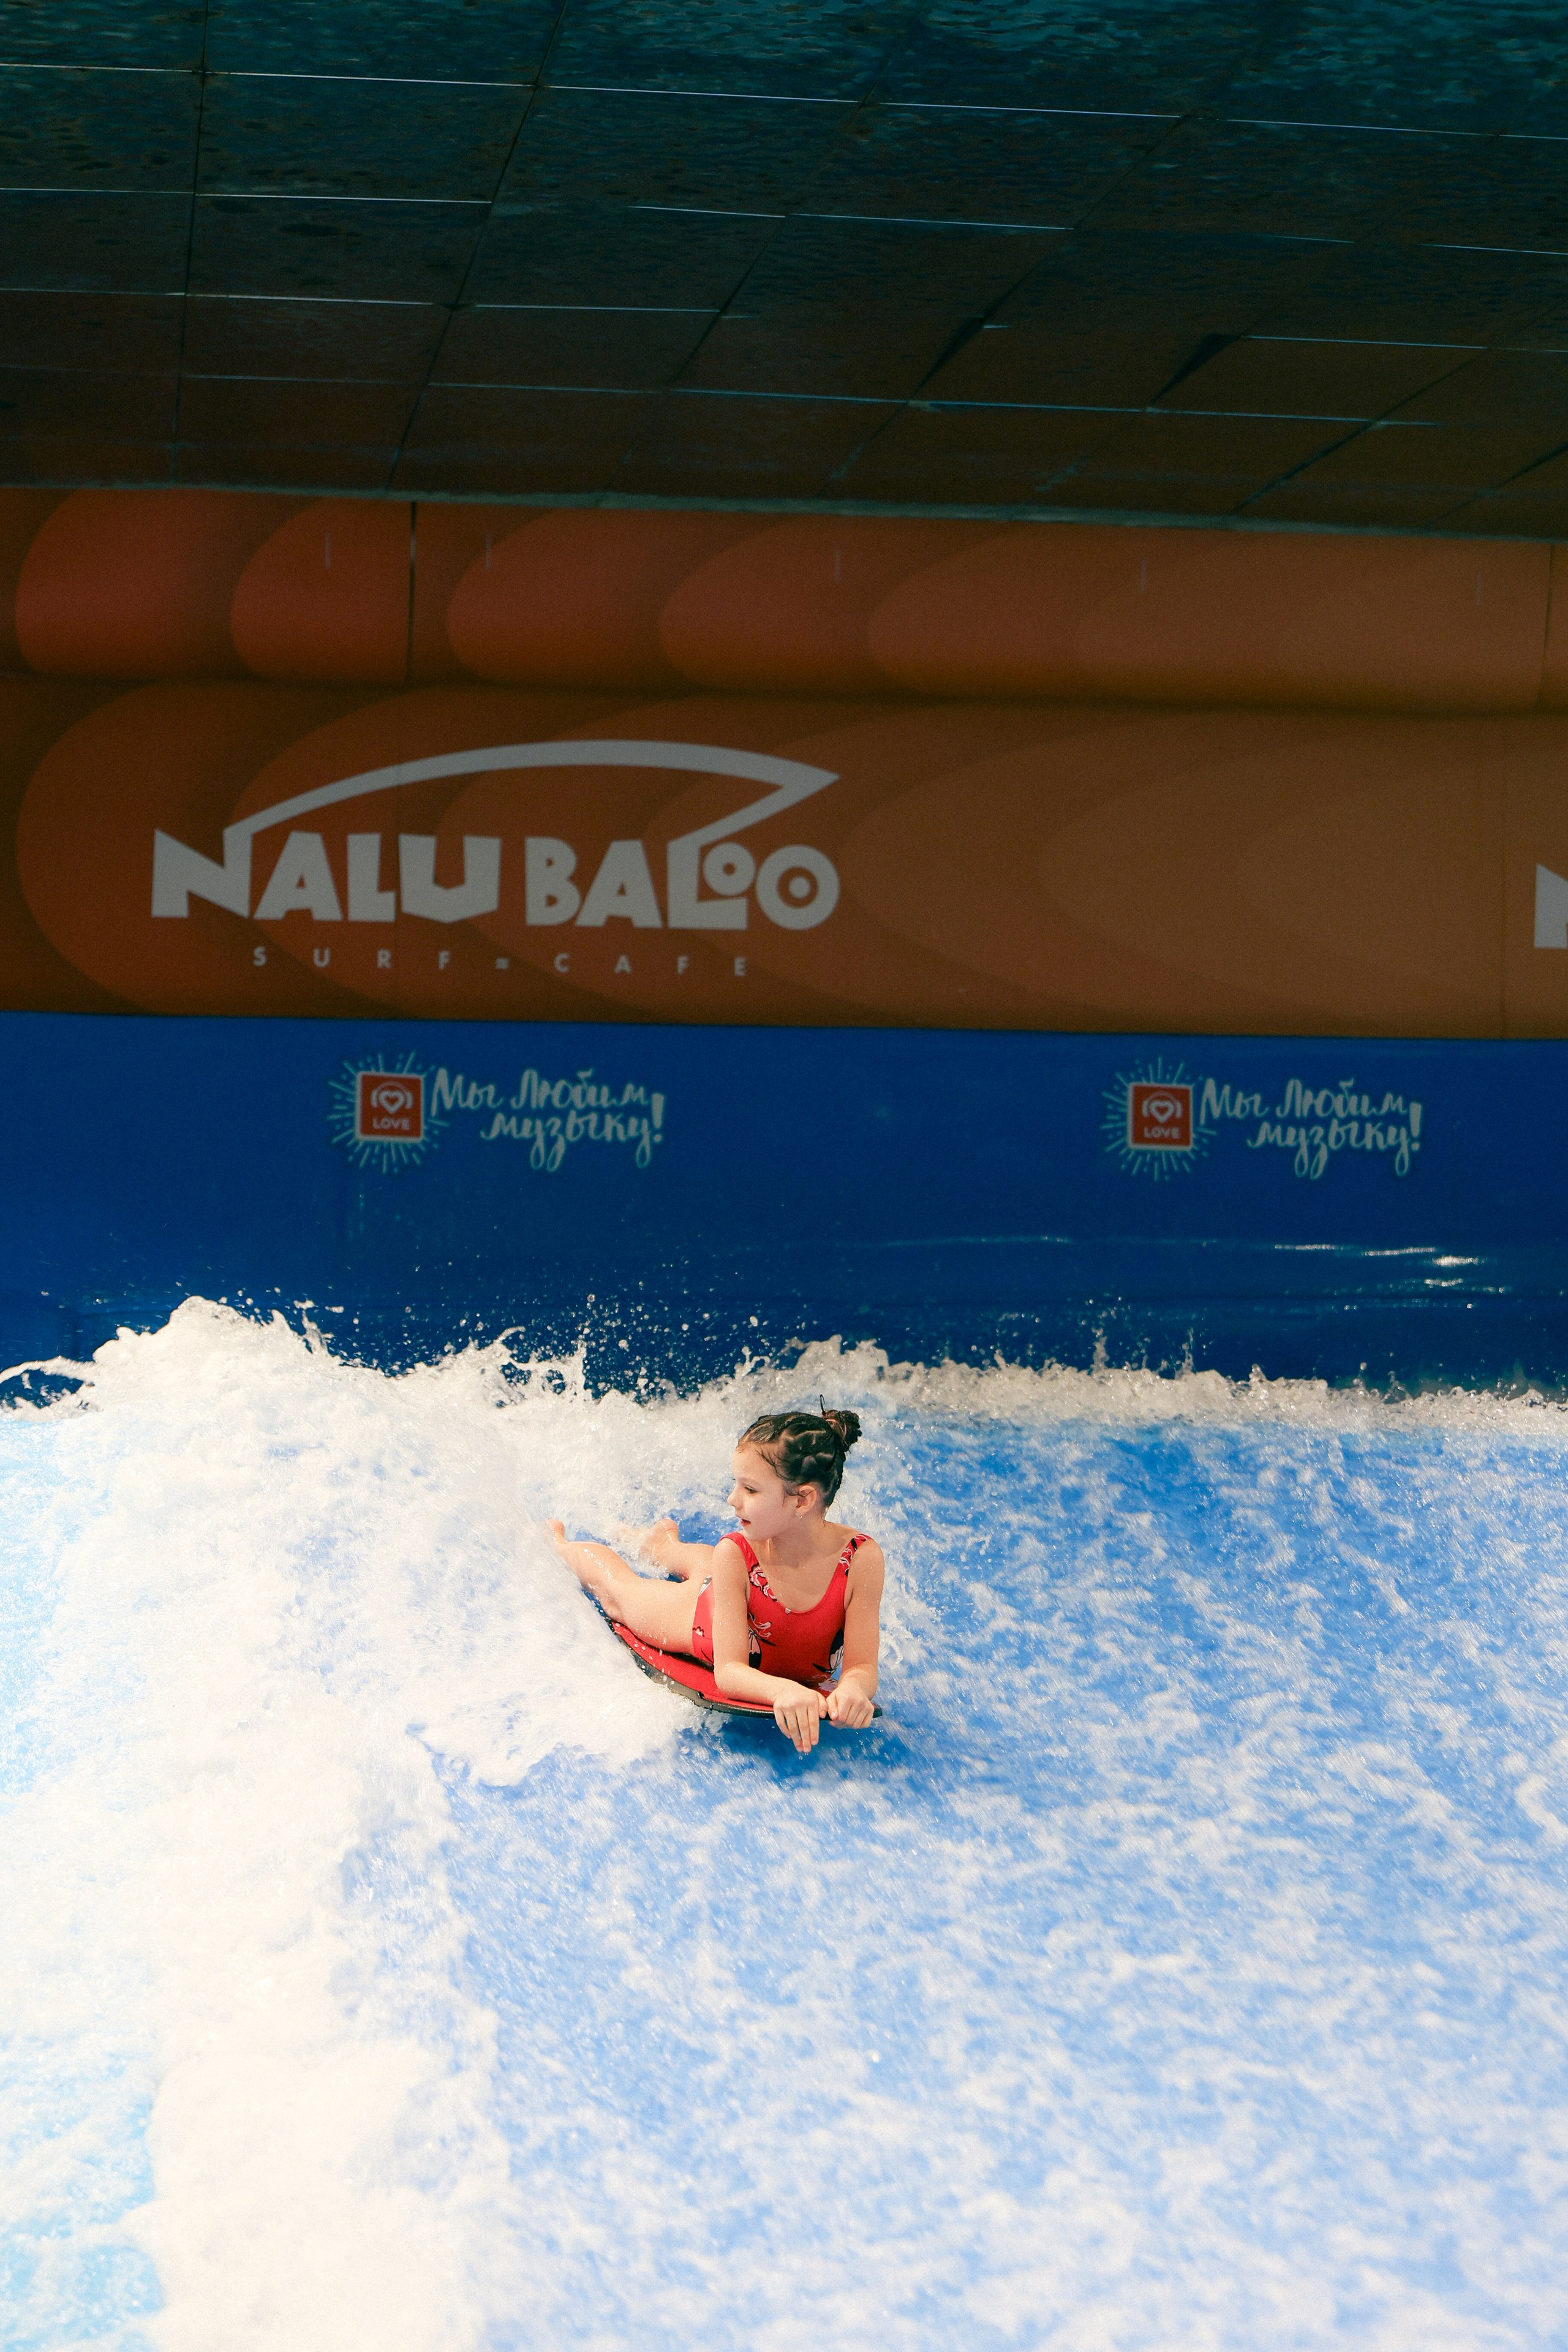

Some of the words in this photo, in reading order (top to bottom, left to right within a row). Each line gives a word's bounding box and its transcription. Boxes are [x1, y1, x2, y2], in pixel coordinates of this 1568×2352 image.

[151, 828, 501, 923] NALU
[525, 836, 840, 930] BALOO
[252, 946, 451, 971] SURF
[553, 952, 746, 977] CAFE
[430, 1066, 504, 1117] Мы
[510, 1067, 650, 1110] Любим
[1199, 1077, 1269, 1126] Мы
[1275, 1077, 1408, 1118] Любим
[372, 1116, 410, 1131] LOVE
[480, 1092, 665, 1172] музыку!
[1144, 1126, 1180, 1140] LOVE
[1246, 1102, 1422, 1180] музыку!
